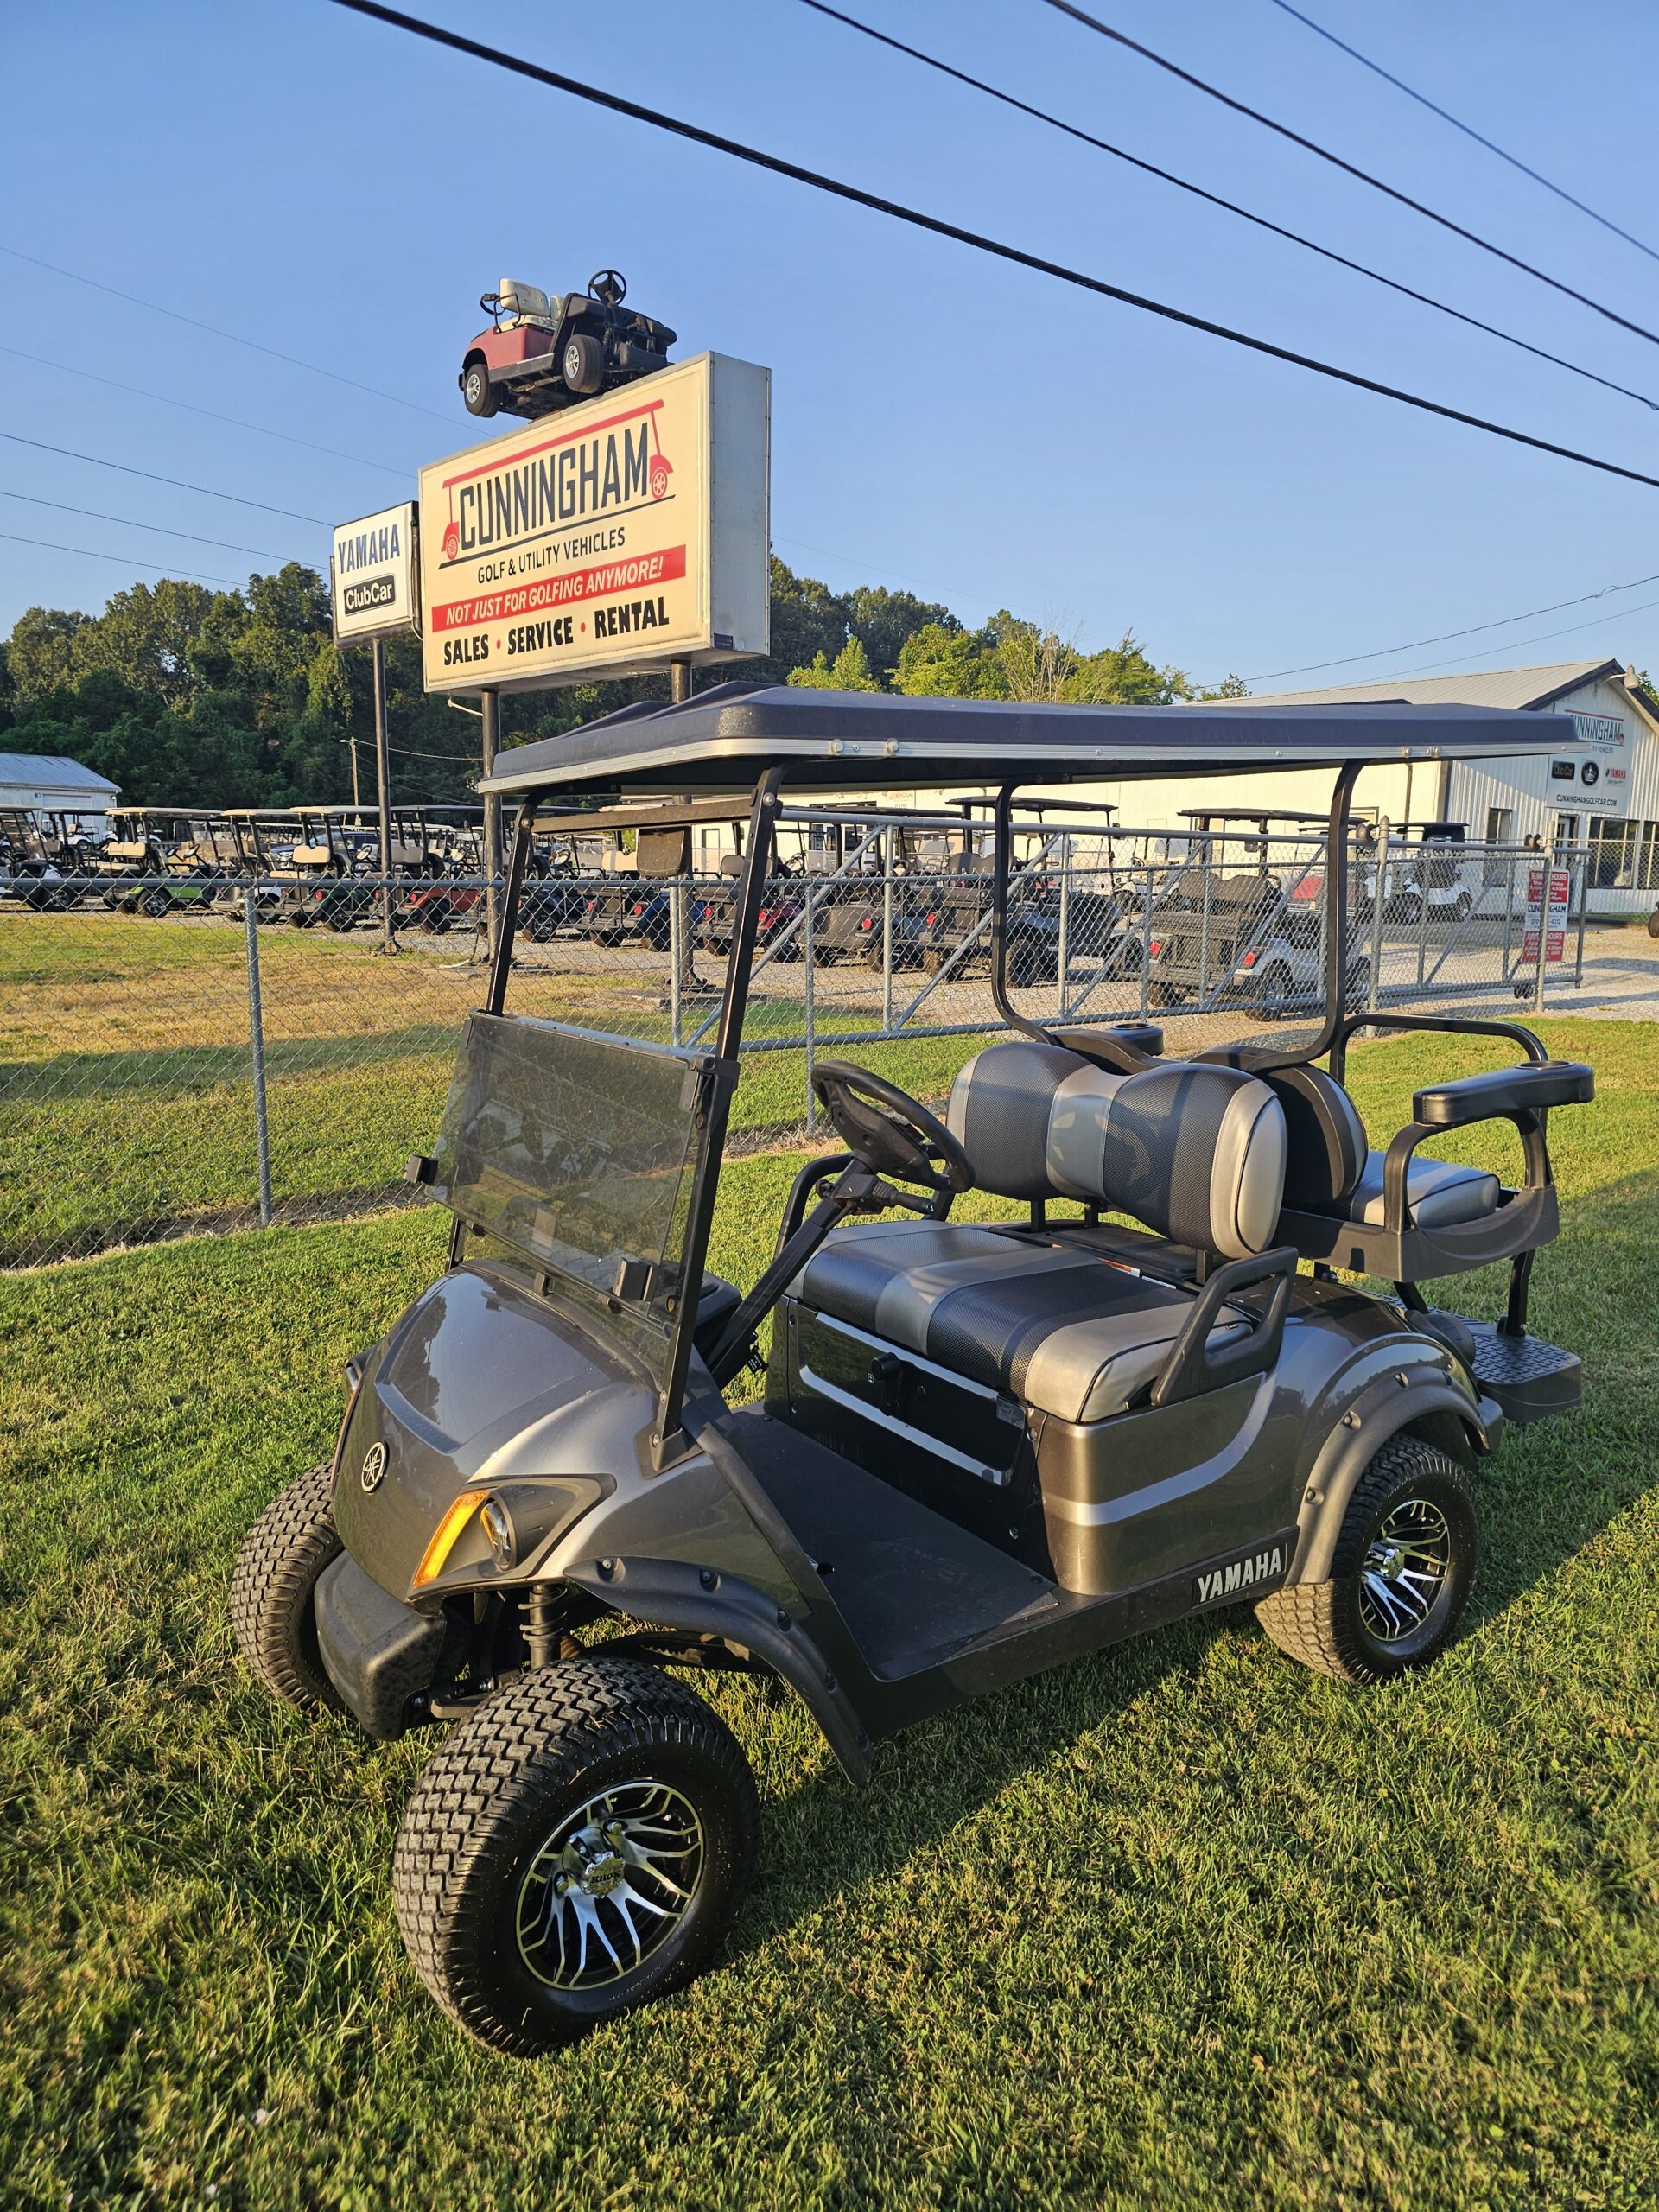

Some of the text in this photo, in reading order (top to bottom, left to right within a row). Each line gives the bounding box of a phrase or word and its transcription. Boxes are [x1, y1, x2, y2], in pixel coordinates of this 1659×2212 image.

[460, 422, 648, 550] CUNNINGHAM
[338, 524, 401, 574] YAMAHA
[478, 526, 625, 583] GOLF & UTILITY VEHICLES
[446, 556, 664, 626] NOT JUST FOR GOLFING ANYMORE!
[444, 596, 670, 666] SALES SERVICE RENTAL
[1570, 715, 1621, 743] NNINGHAM
[1556, 794, 1618, 806] CUNNINGHAMGOLFCAR.COM
[1551, 873, 1567, 881] HOURS
[1198, 1548, 1281, 1603] YAMAHA
